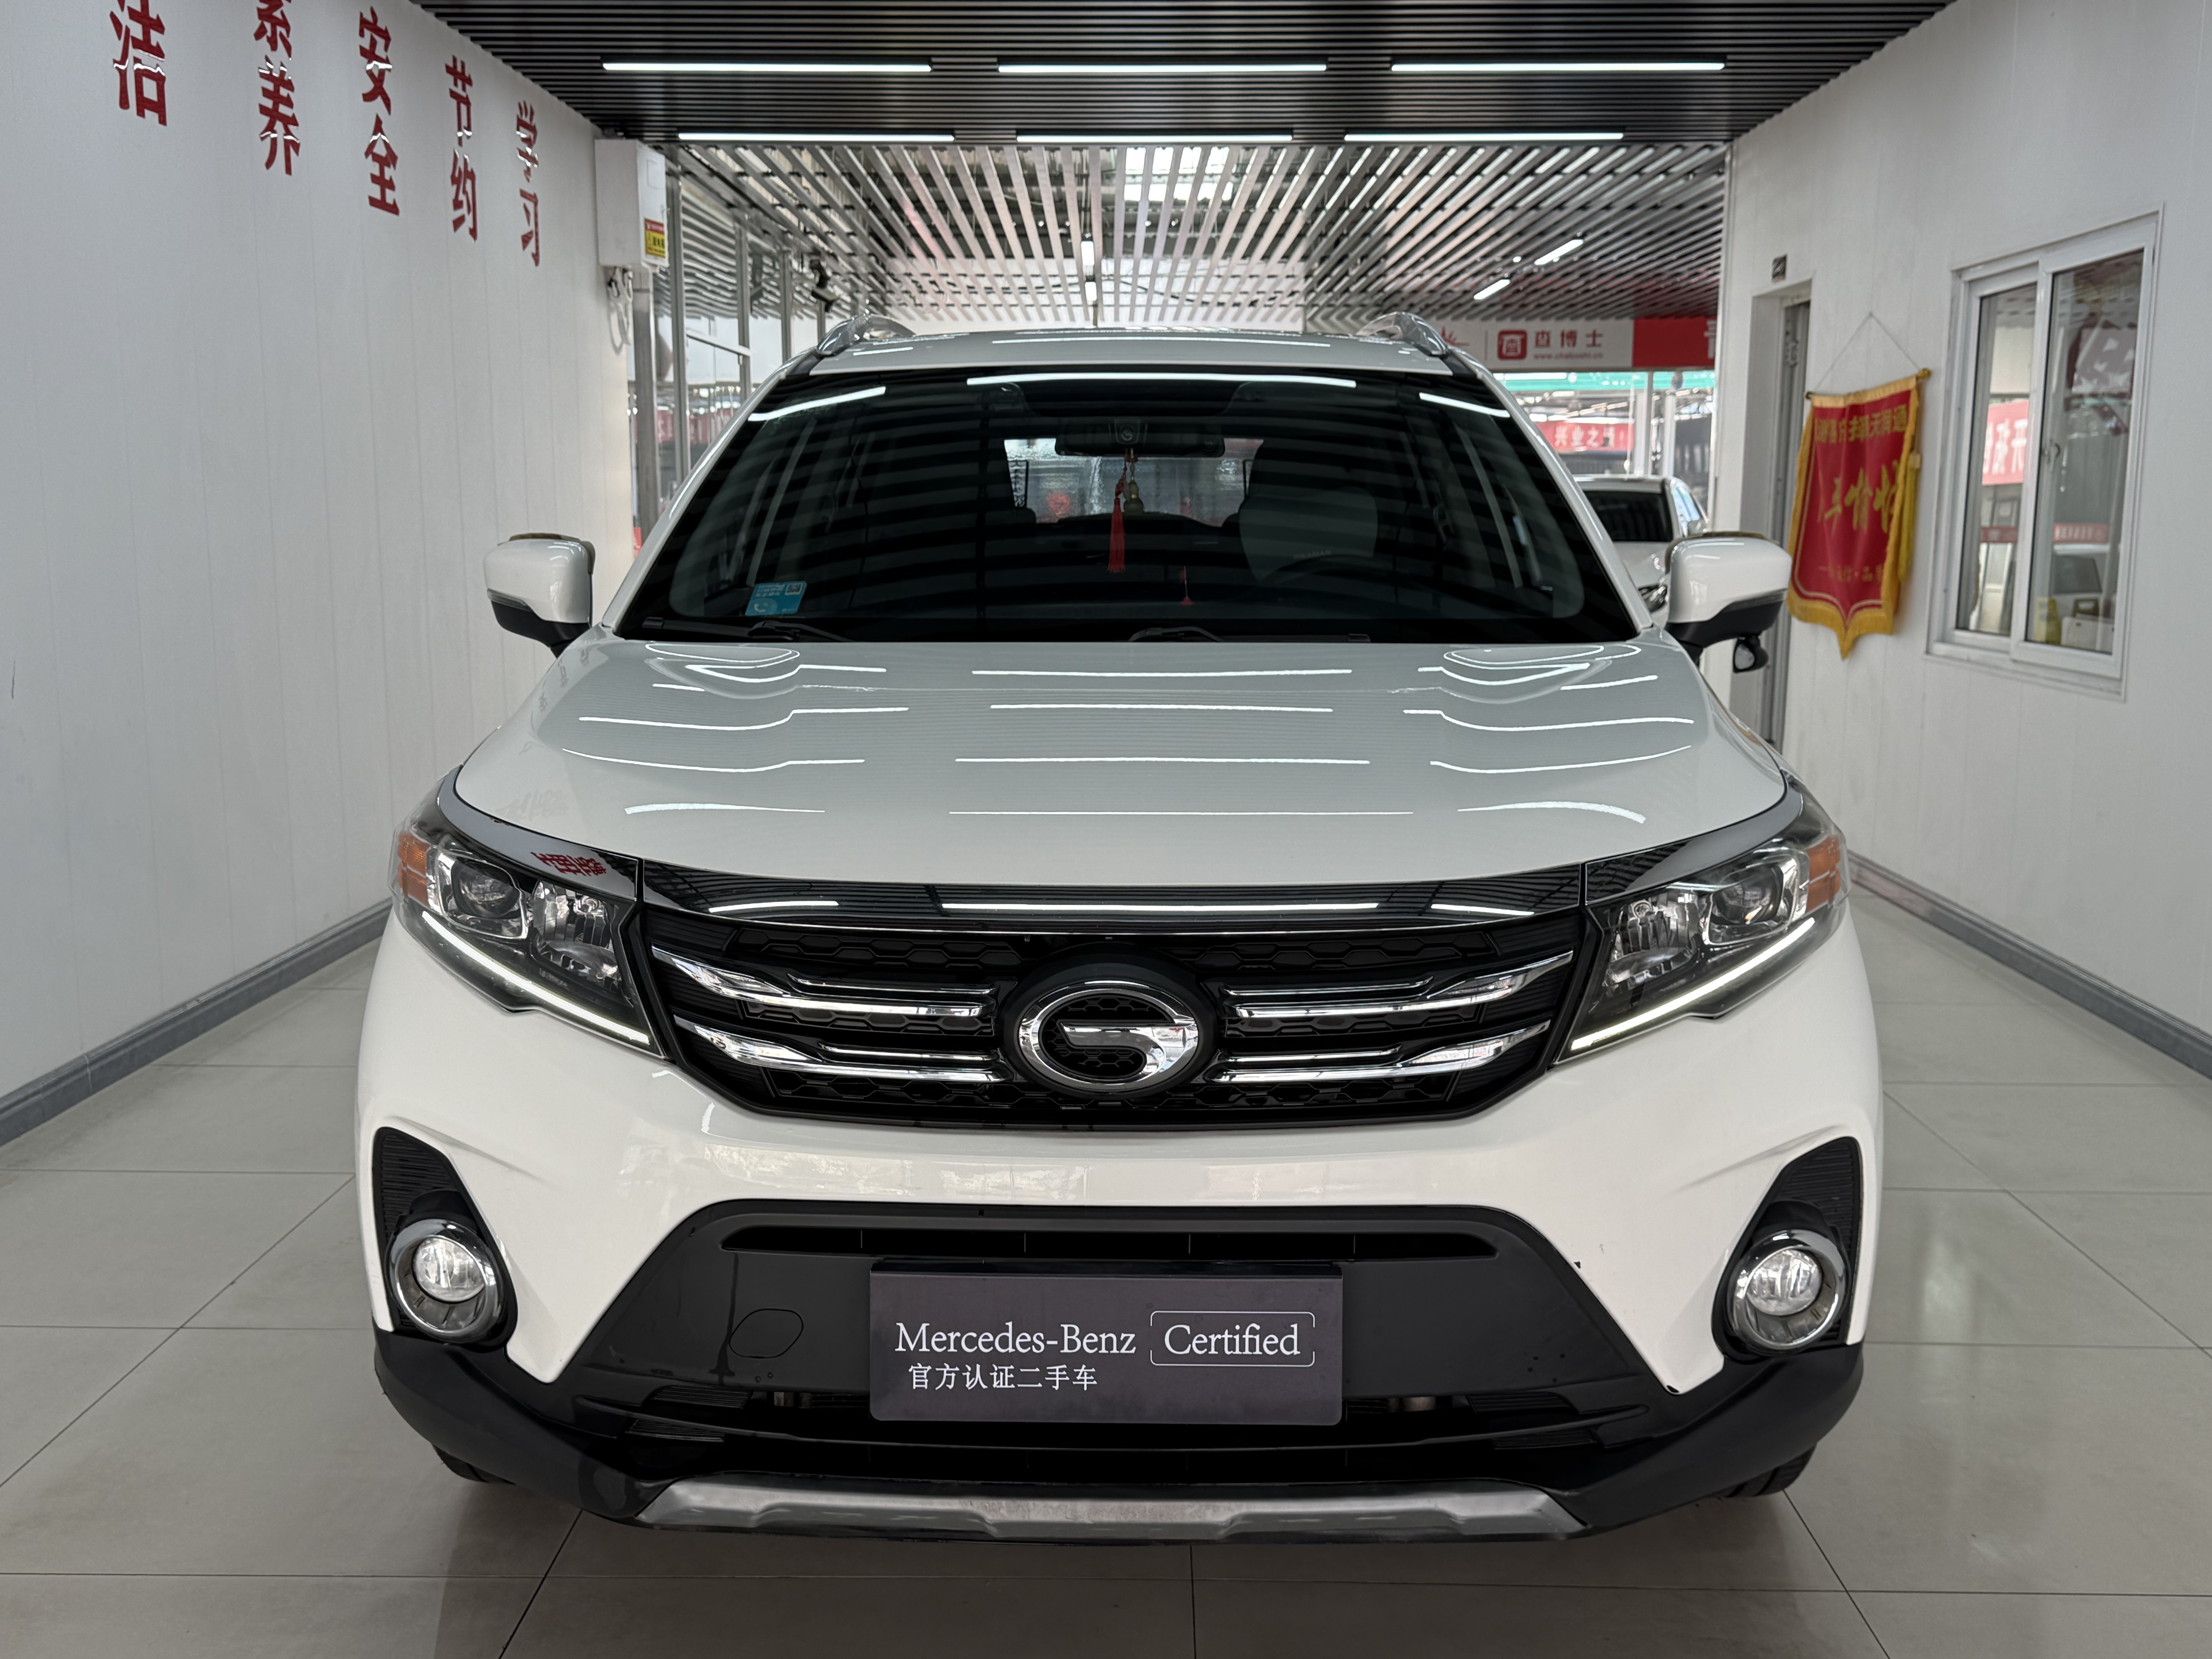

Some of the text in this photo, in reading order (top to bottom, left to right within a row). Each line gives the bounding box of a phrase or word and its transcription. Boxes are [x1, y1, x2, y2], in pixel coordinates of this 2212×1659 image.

[359, 6, 400, 215] 安全
[445, 55, 478, 242] 节约
[516, 101, 539, 266] 学习
[1534, 330, 1603, 348] 查博士
[895, 1321, 1301, 1355] Mercedes-Benz Certified
[908, 1362, 1097, 1391] 官方认证二手车
